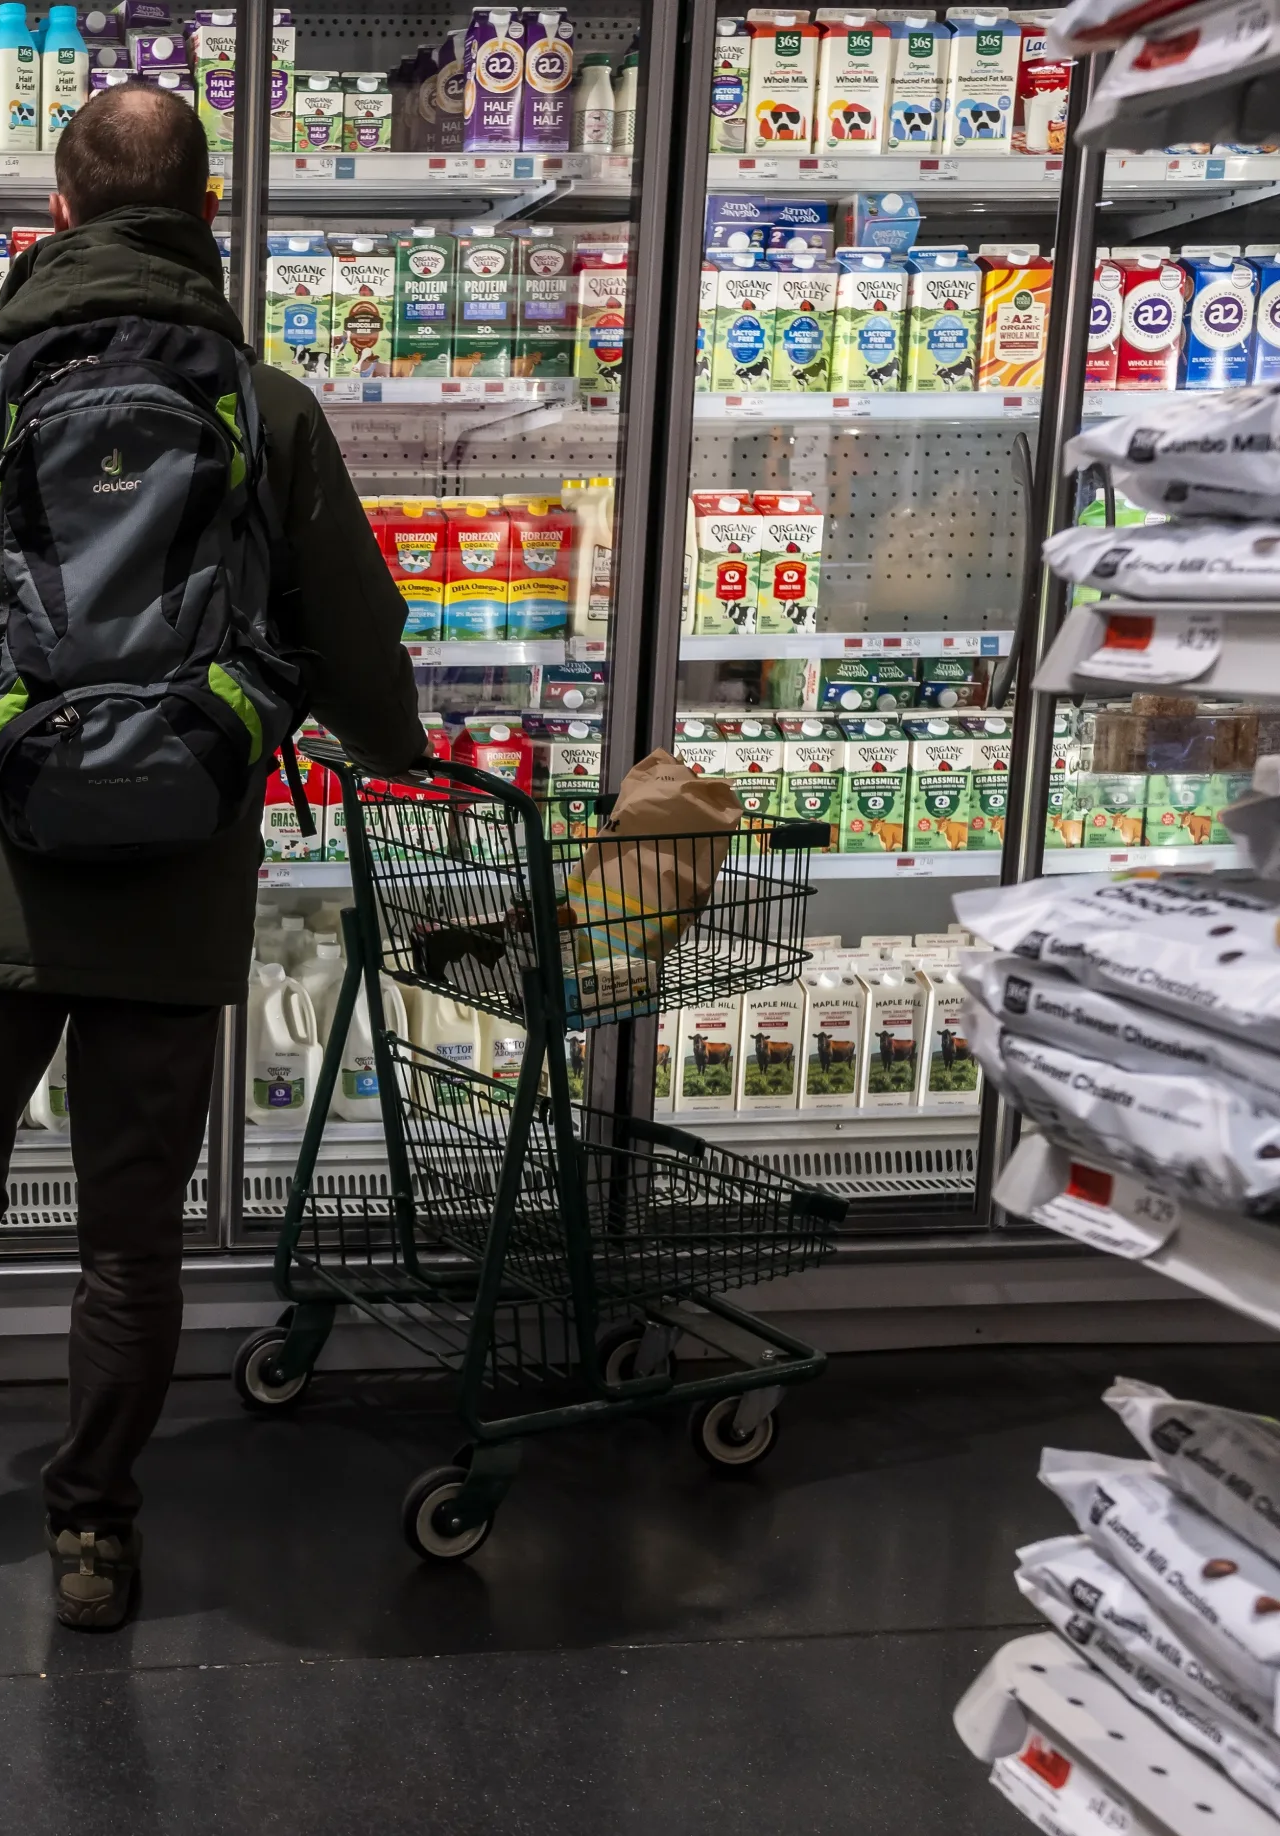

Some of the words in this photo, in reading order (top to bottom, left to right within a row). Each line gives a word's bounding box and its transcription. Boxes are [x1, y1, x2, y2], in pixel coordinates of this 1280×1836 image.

[778, 35, 799, 48] 365
[979, 34, 1000, 47] 365
[489, 58, 512, 73] a2
[538, 57, 561, 73] a2
[210, 80, 234, 88] HALF
[790, 76, 807, 84] Milk
[21, 83, 35, 91] Half
[355, 99, 383, 110] ORGANIC
[360, 104, 380, 113] VALLEY
[484, 102, 514, 111] HALF
[534, 102, 563, 111] HALF
[483, 115, 514, 125] HALF
[533, 116, 563, 125] HALF
[277, 265, 327, 277] ORGANIC
[281, 274, 321, 285] VALLEY
[405, 281, 447, 293] PROTEIN
[726, 280, 772, 293] ORGANIC
[730, 289, 768, 300] VALLEY
[1011, 315, 1032, 323] A2
[1138, 305, 1168, 325] a2
[1209, 304, 1239, 324] a2
[1000, 332, 1019, 340] WHOLE
[1021, 332, 1039, 340] MILK
[93, 478, 142, 493] deuter
[769, 524, 817, 535] ORGANIC
[458, 532, 500, 541] HORIZON
[773, 532, 813, 543] VALLEY
[452, 584, 468, 592] DHA
[470, 583, 504, 592] Omega-3
[486, 752, 521, 760] HORIZON
[859, 747, 898, 756] ORGANIC
[862, 753, 895, 763] VALLEY
[1034, 998, 1119, 1036] Semi-Sweet
[437, 1046, 453, 1054] SKY
[456, 1045, 472, 1053] TOP
[1106, 1512, 1145, 1553] Jumbo
[1146, 1549, 1168, 1576] Milk
